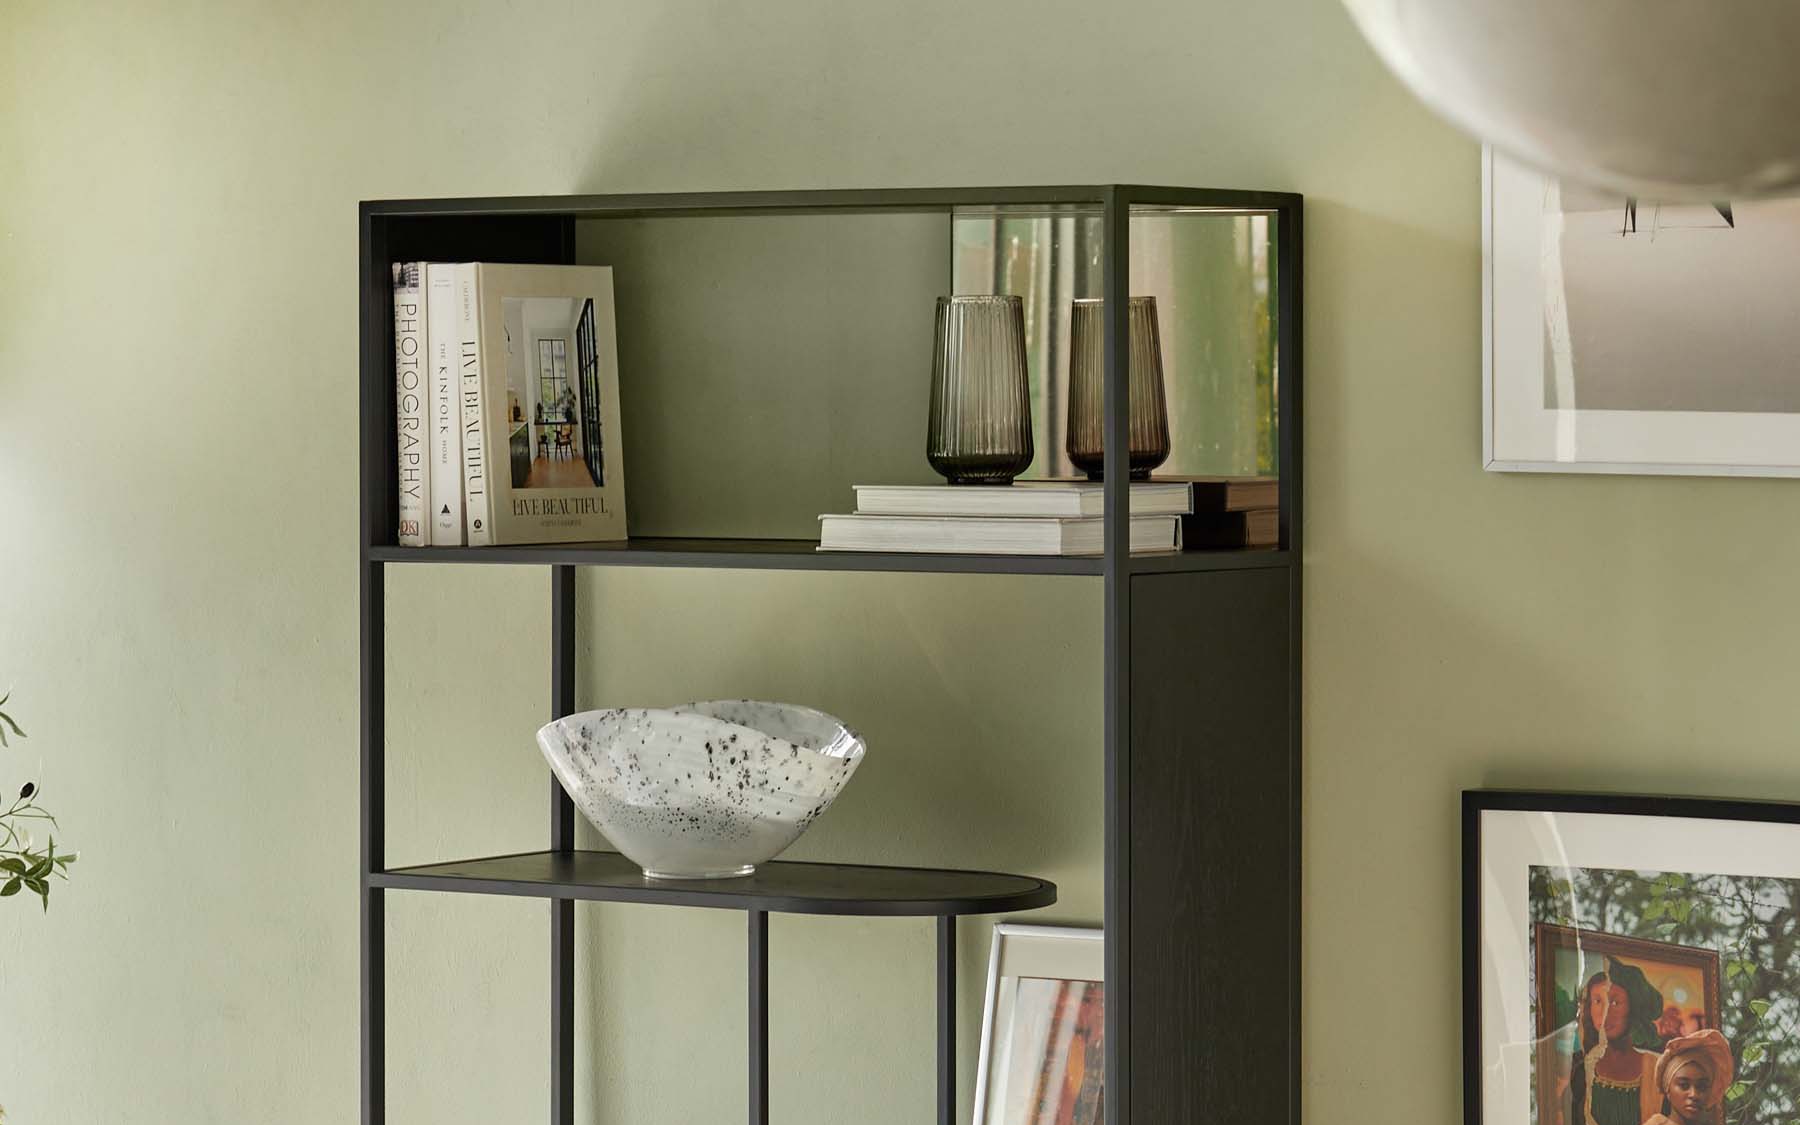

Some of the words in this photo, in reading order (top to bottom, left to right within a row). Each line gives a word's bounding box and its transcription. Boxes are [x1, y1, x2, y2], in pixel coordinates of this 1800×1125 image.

[462, 341, 478, 387] LIVE
[400, 304, 420, 499] PHOTOGRAPHY
[439, 366, 449, 433] KINFOLK
[465, 391, 484, 502] BEAUTIFUL
[513, 498, 539, 516] LIVE
[542, 496, 608, 515] BEAUTIFUL
